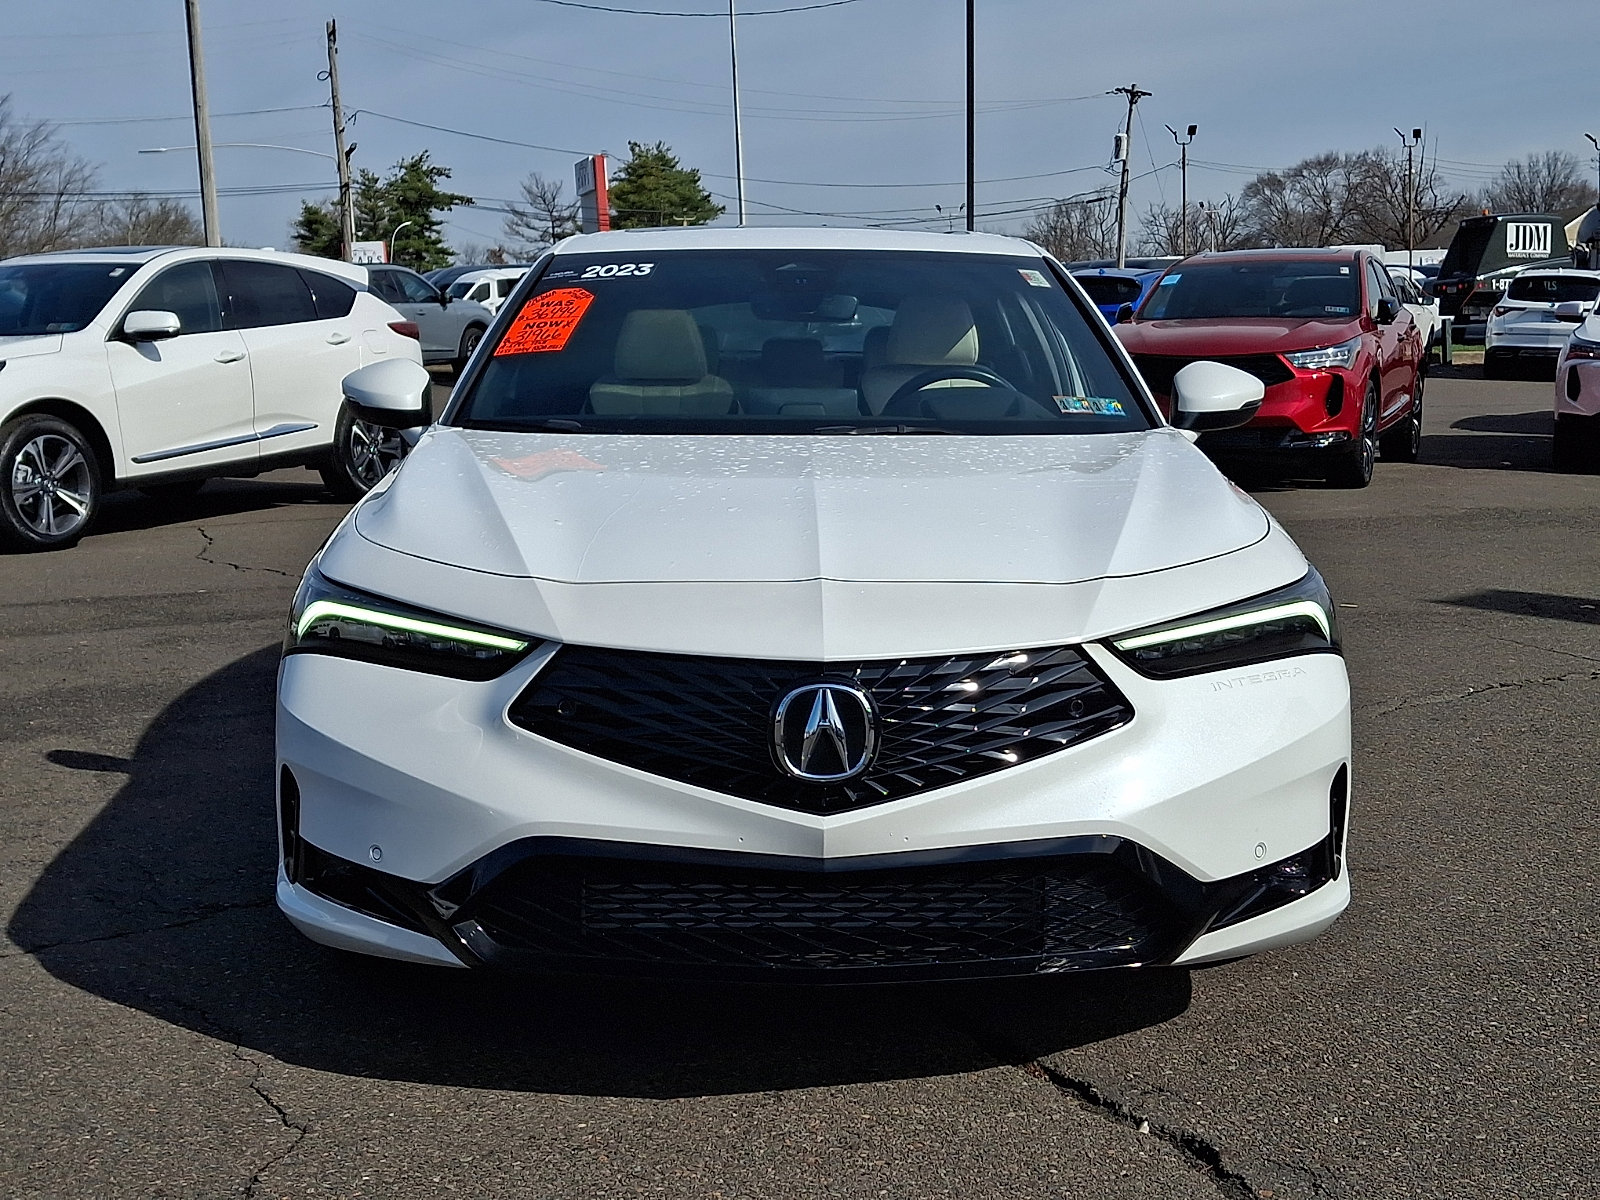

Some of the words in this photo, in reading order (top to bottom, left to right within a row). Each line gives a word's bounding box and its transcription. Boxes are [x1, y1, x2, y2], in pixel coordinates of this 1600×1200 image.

[1509, 224, 1549, 251] JDM
[580, 263, 654, 279] 2023
[540, 299, 575, 308] WAS
[522, 320, 563, 330] NOW
[1210, 666, 1306, 692] INTEGRA
